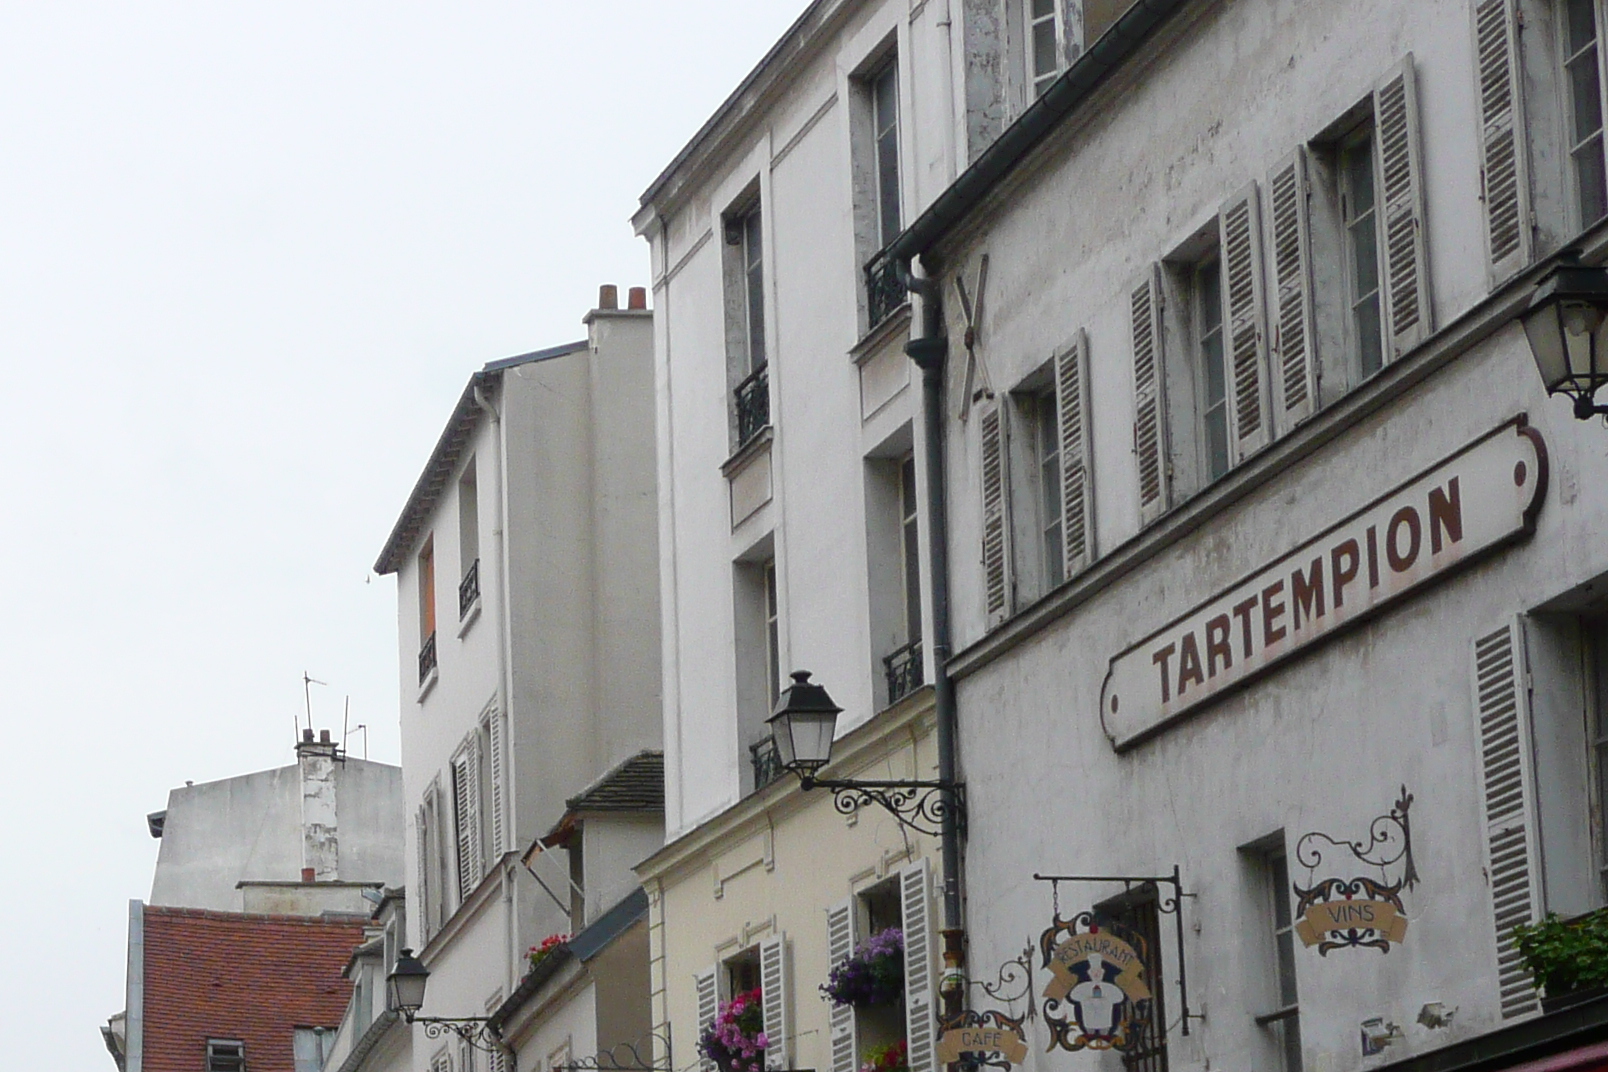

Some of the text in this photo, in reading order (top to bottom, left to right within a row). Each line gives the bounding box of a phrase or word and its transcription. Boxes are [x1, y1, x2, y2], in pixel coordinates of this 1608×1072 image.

[1153, 475, 1463, 705] TARTEMPION
[1327, 904, 1375, 924] VINS
[1060, 937, 1135, 966] RESTAURANT
